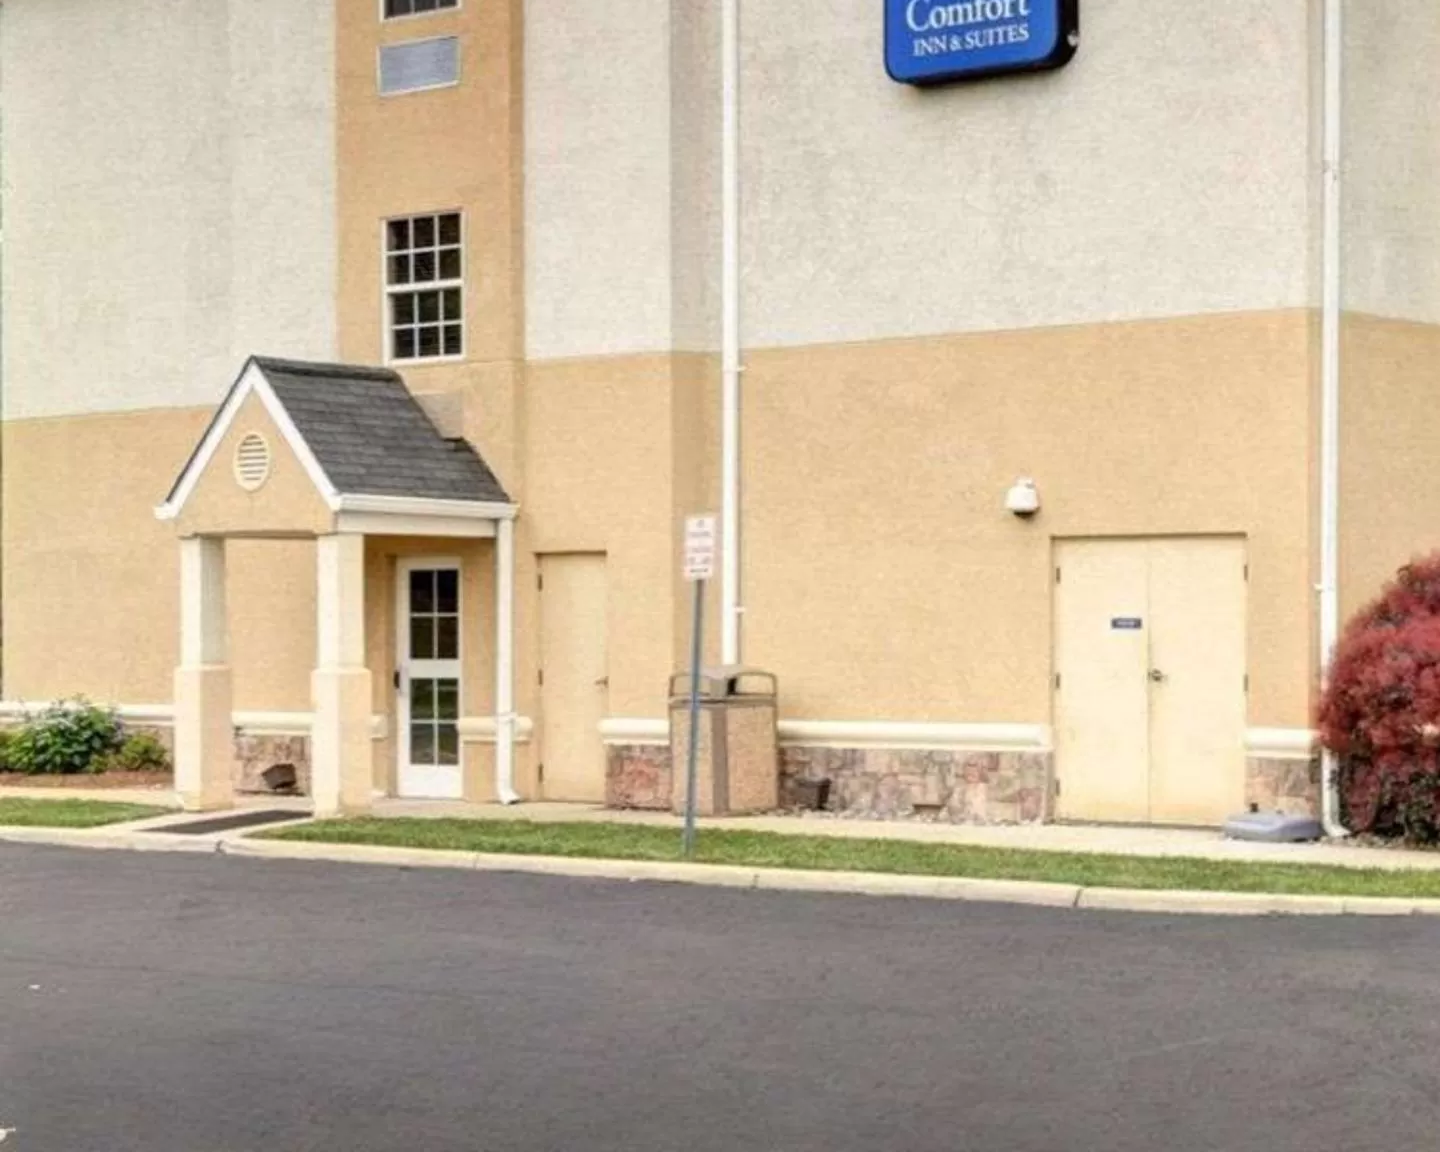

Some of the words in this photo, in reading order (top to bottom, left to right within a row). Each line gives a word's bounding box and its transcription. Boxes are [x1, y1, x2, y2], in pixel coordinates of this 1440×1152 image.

[913, 35, 947, 56] INN
[949, 34, 962, 52] &
[964, 23, 1029, 49] SUITES
